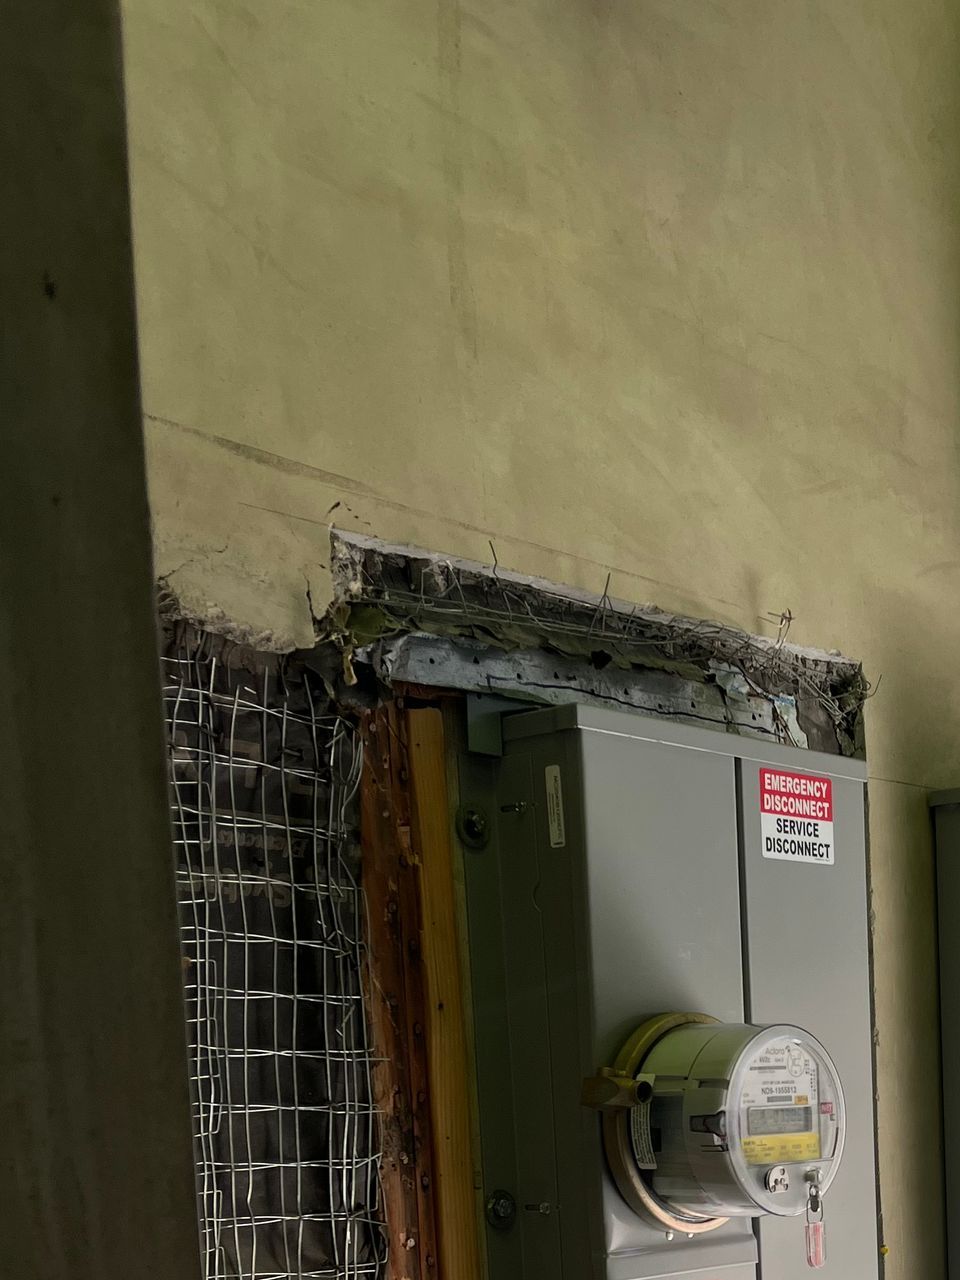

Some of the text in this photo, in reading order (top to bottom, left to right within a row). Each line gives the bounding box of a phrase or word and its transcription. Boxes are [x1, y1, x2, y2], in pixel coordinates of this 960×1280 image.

[764, 773, 828, 798] EMERGENCY
[763, 793, 829, 818] DISCONNECT
[776, 818, 820, 838] SERVICE
[765, 836, 831, 859] DISCONNECT
